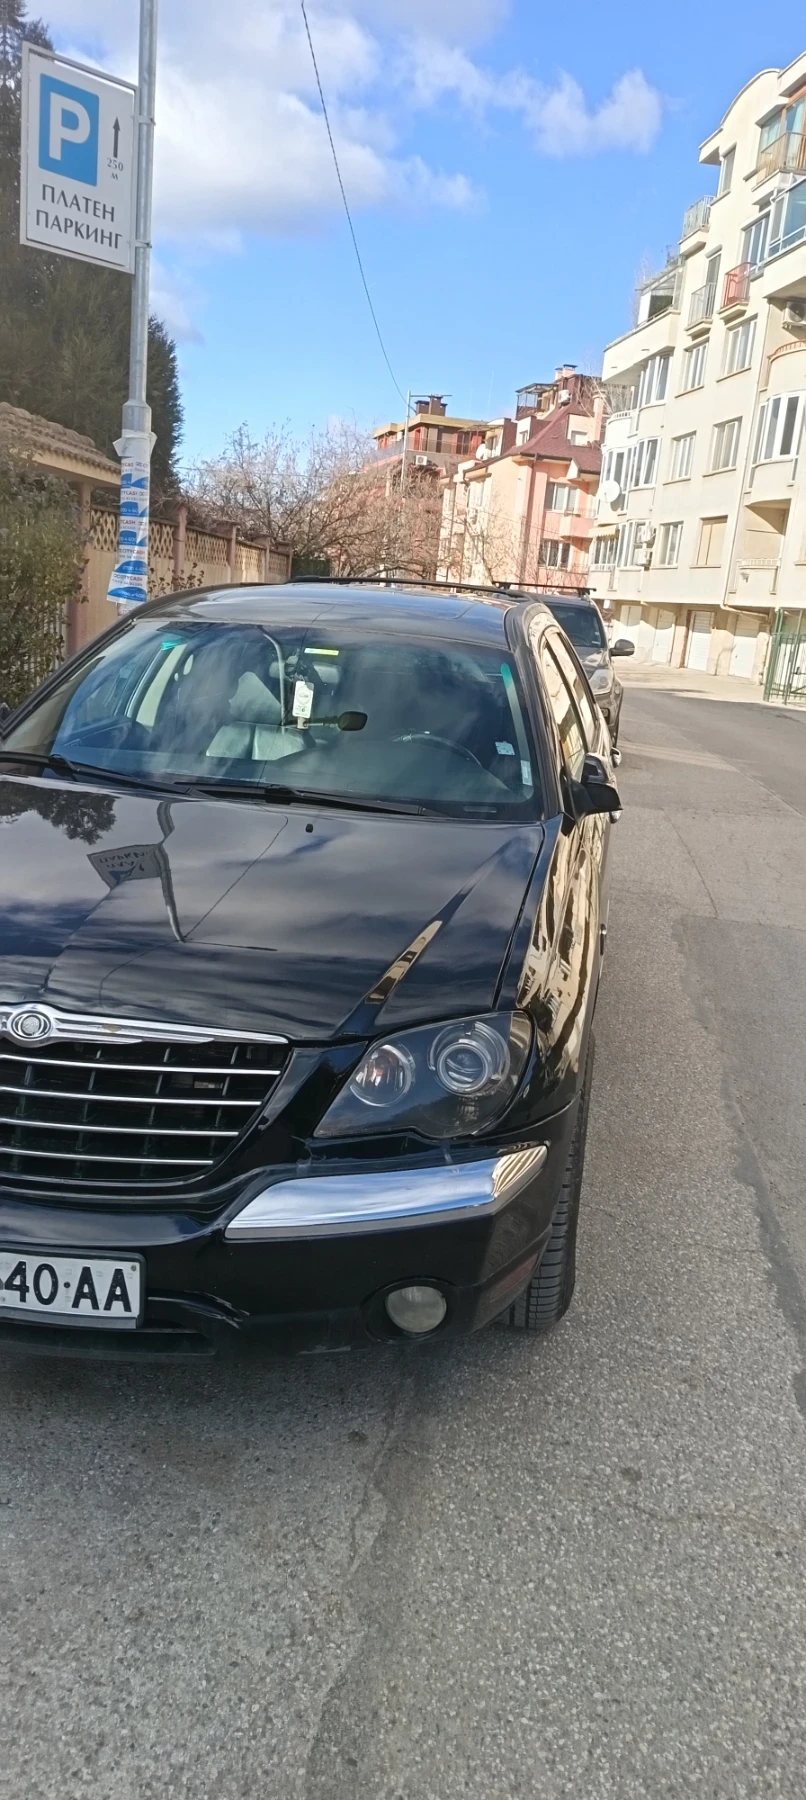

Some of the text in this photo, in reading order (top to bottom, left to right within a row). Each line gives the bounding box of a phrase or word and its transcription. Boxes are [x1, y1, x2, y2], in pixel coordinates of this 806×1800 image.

[49, 91, 91, 161] P
[106, 157, 124, 172] 250
[42, 183, 115, 223] ПЛАТЕН
[35, 208, 123, 249] ПАРКИНГ
